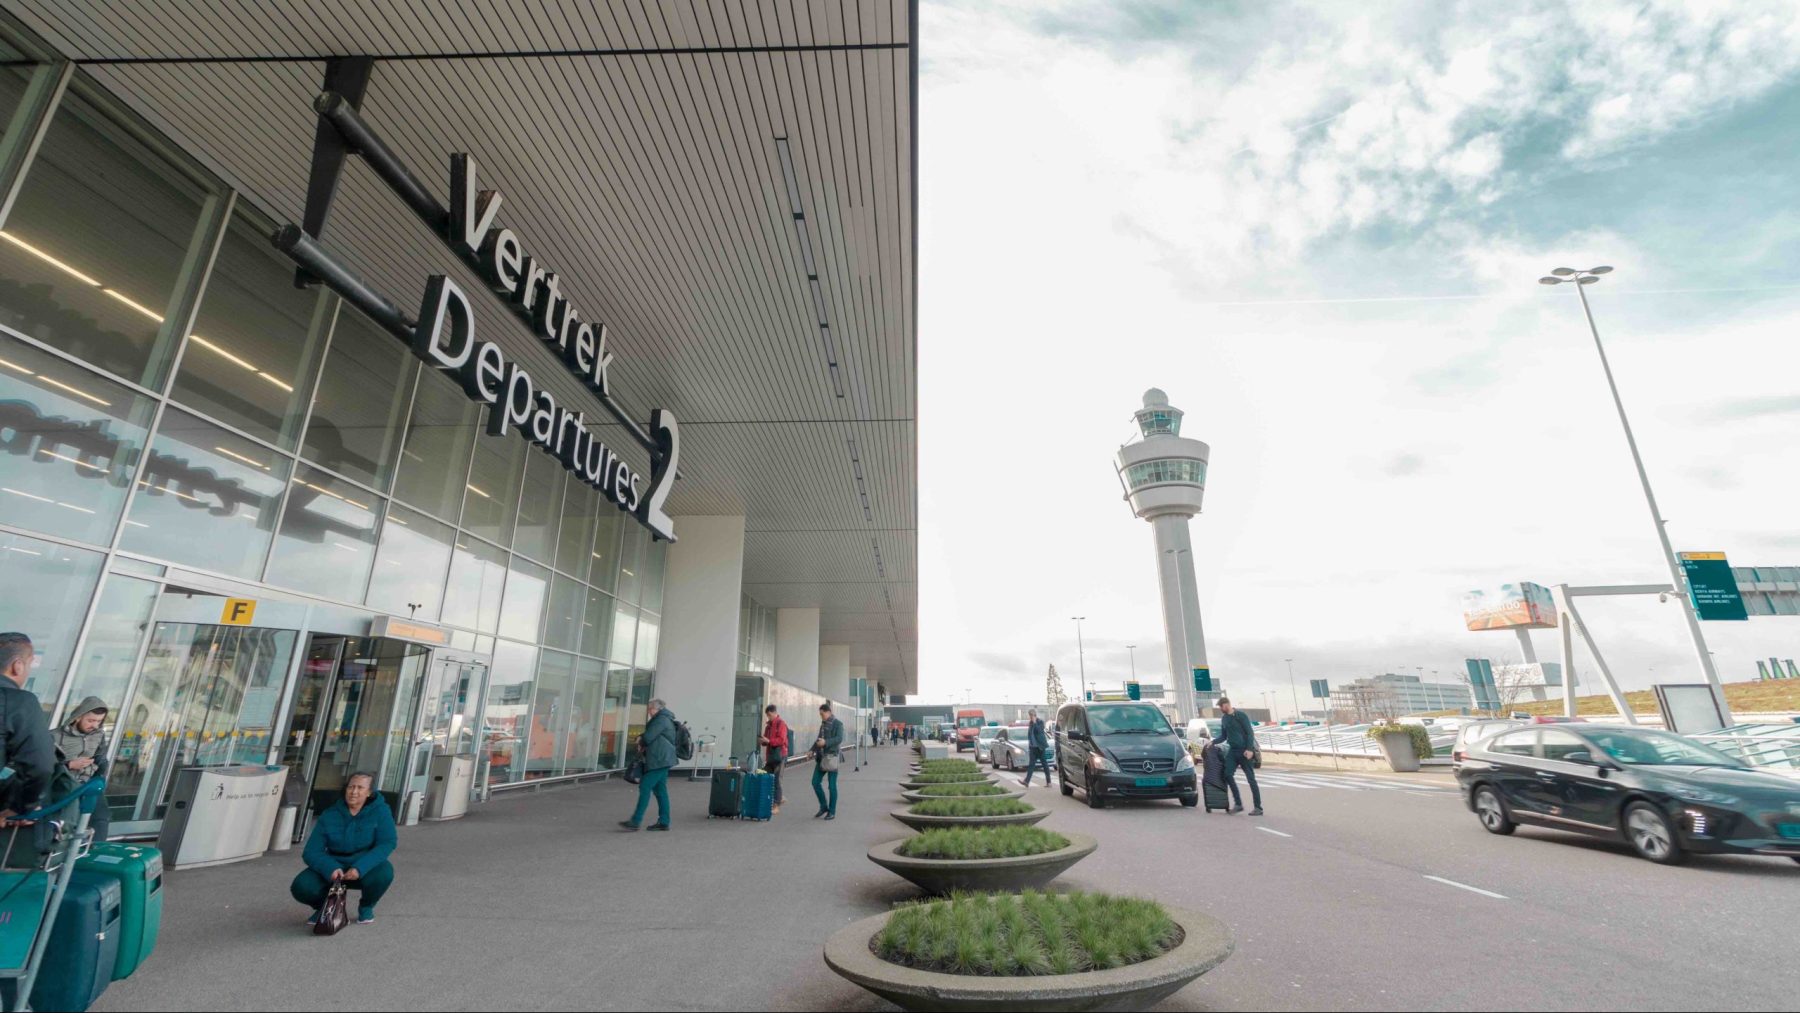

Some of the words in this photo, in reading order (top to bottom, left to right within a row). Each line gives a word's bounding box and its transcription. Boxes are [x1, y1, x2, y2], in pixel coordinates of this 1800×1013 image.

[460, 153, 614, 395] Vertrek
[425, 275, 640, 512] Departures
[644, 409, 680, 539] 2
[230, 602, 248, 621] F
